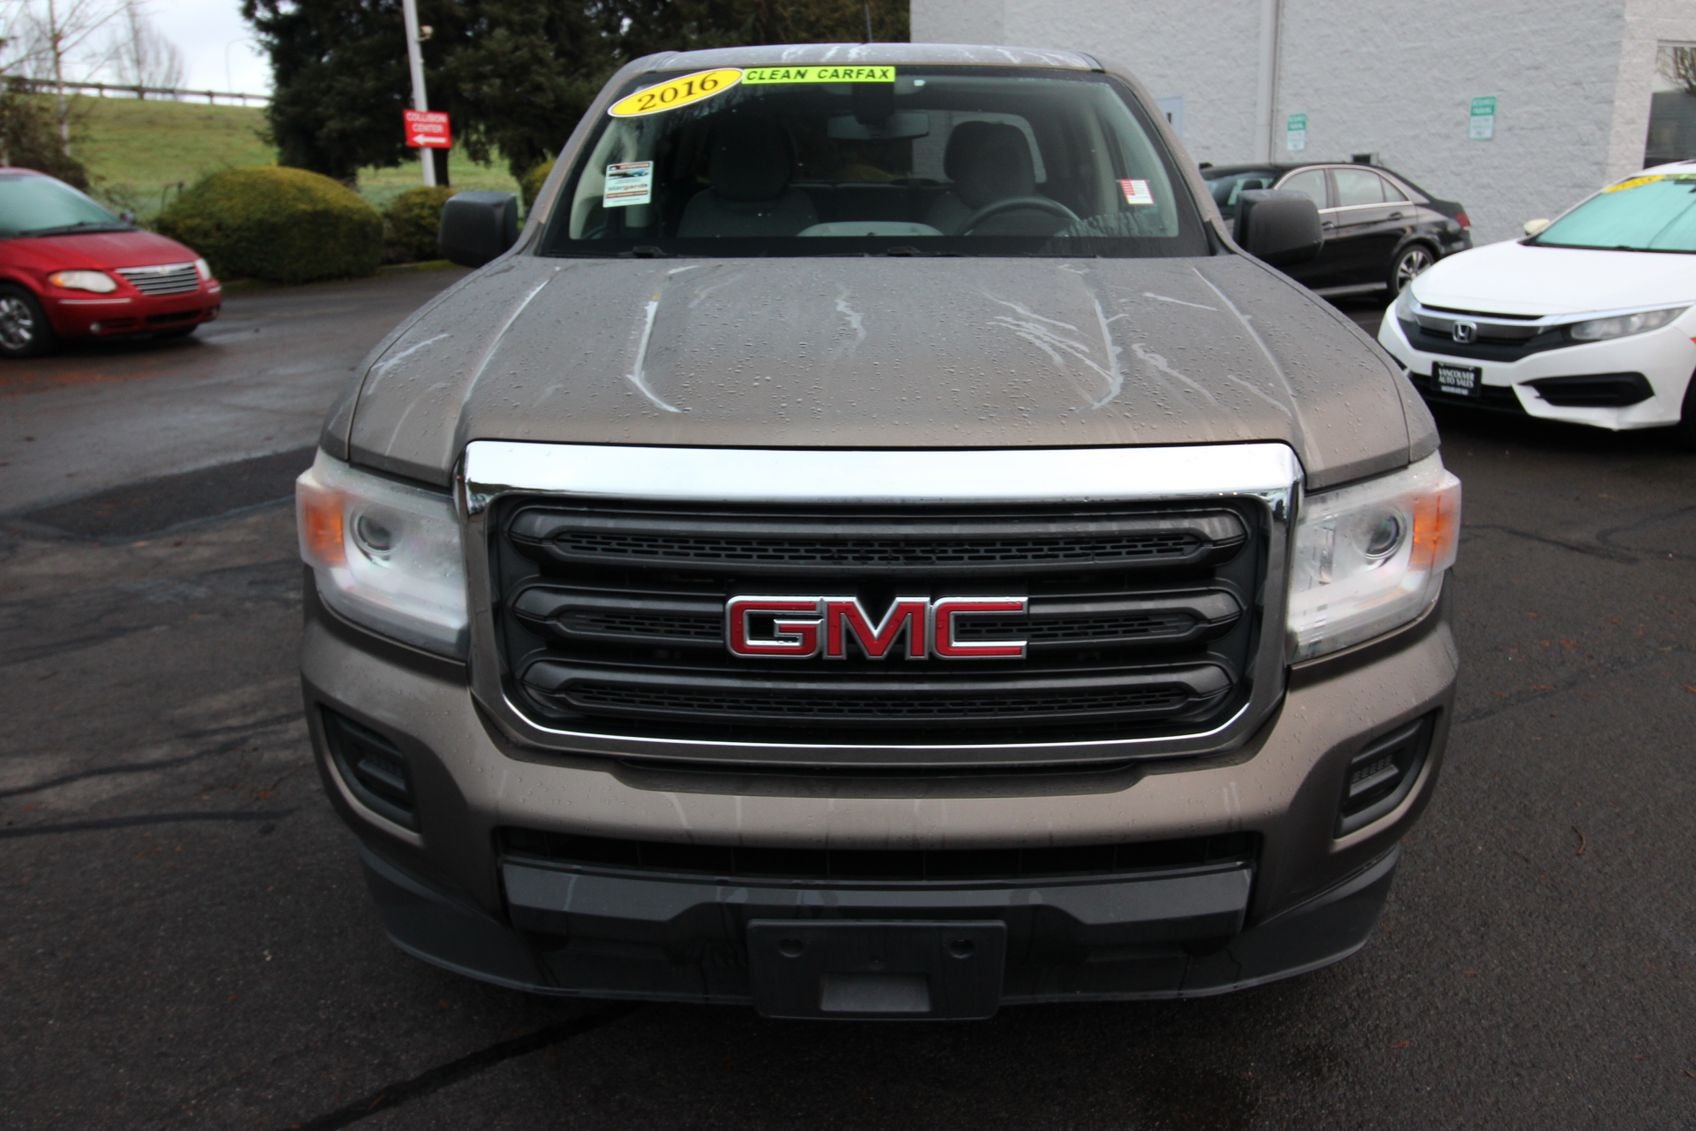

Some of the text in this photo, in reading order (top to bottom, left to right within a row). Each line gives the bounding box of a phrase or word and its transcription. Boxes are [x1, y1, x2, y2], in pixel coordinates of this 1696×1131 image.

[636, 72, 719, 112] 2016
[746, 68, 891, 81] CLEAN CARFAX
[725, 595, 1028, 660] GMC
